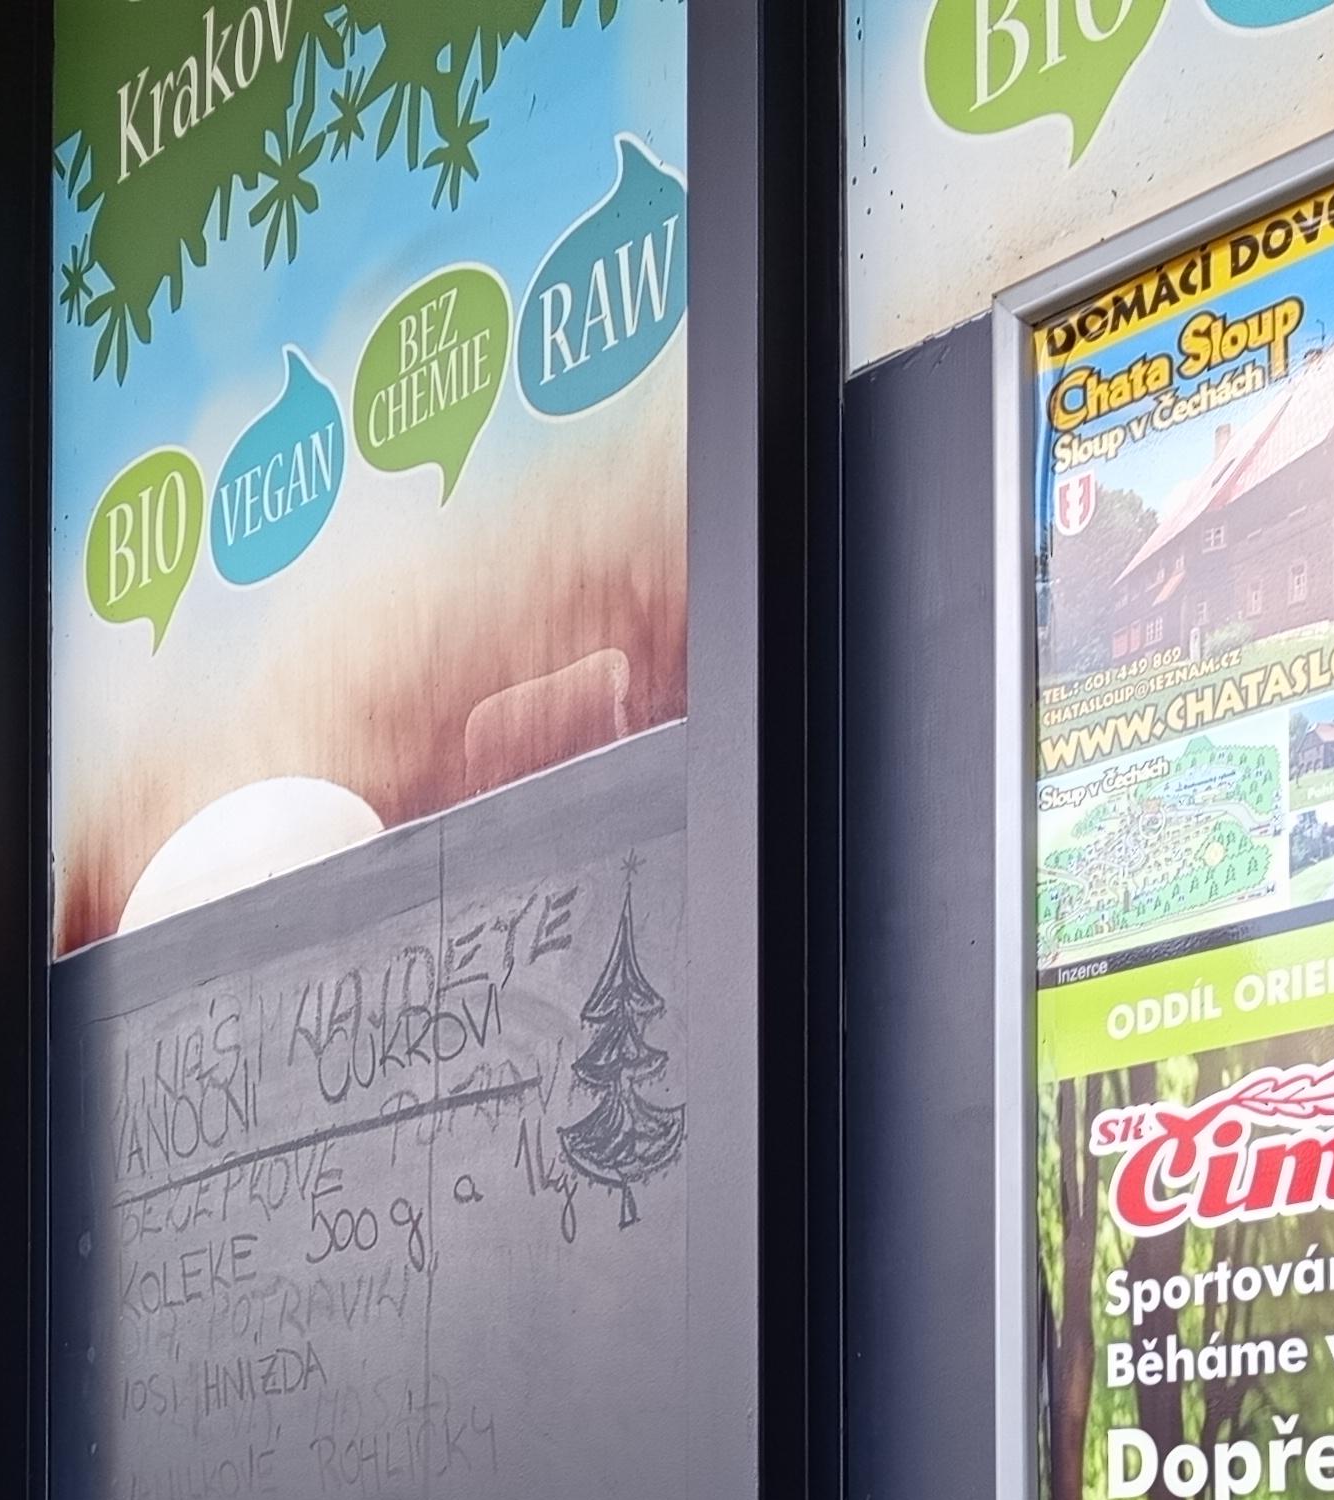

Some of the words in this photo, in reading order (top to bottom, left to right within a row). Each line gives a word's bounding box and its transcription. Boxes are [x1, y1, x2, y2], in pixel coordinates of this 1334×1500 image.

[117, 0, 293, 183] Krakov
[398, 287, 458, 372] BEZ
[539, 215, 679, 386] RAW
[368, 329, 491, 448] CHEMIE
[1048, 353, 1174, 431] Chata
[1177, 296, 1305, 382] Sloup
[1053, 425, 1127, 474] Sloup
[1127, 412, 1151, 443] v
[1151, 360, 1267, 431] Čechách
[220, 423, 335, 547] VEGAN
[106, 470, 186, 606] BIO
[1043, 649, 1242, 727] CHATASLOUP@SEZNAM.CZ
[1084, 672, 1111, 692] 601
[1117, 658, 1148, 680] 449
[1153, 646, 1182, 668] 869
[1058, 960, 1108, 985] Inzerce
[1106, 976, 1222, 1042] ODDÍL
[453, 1174, 484, 1204] a
[1106, 1333, 1308, 1388] Běháme
